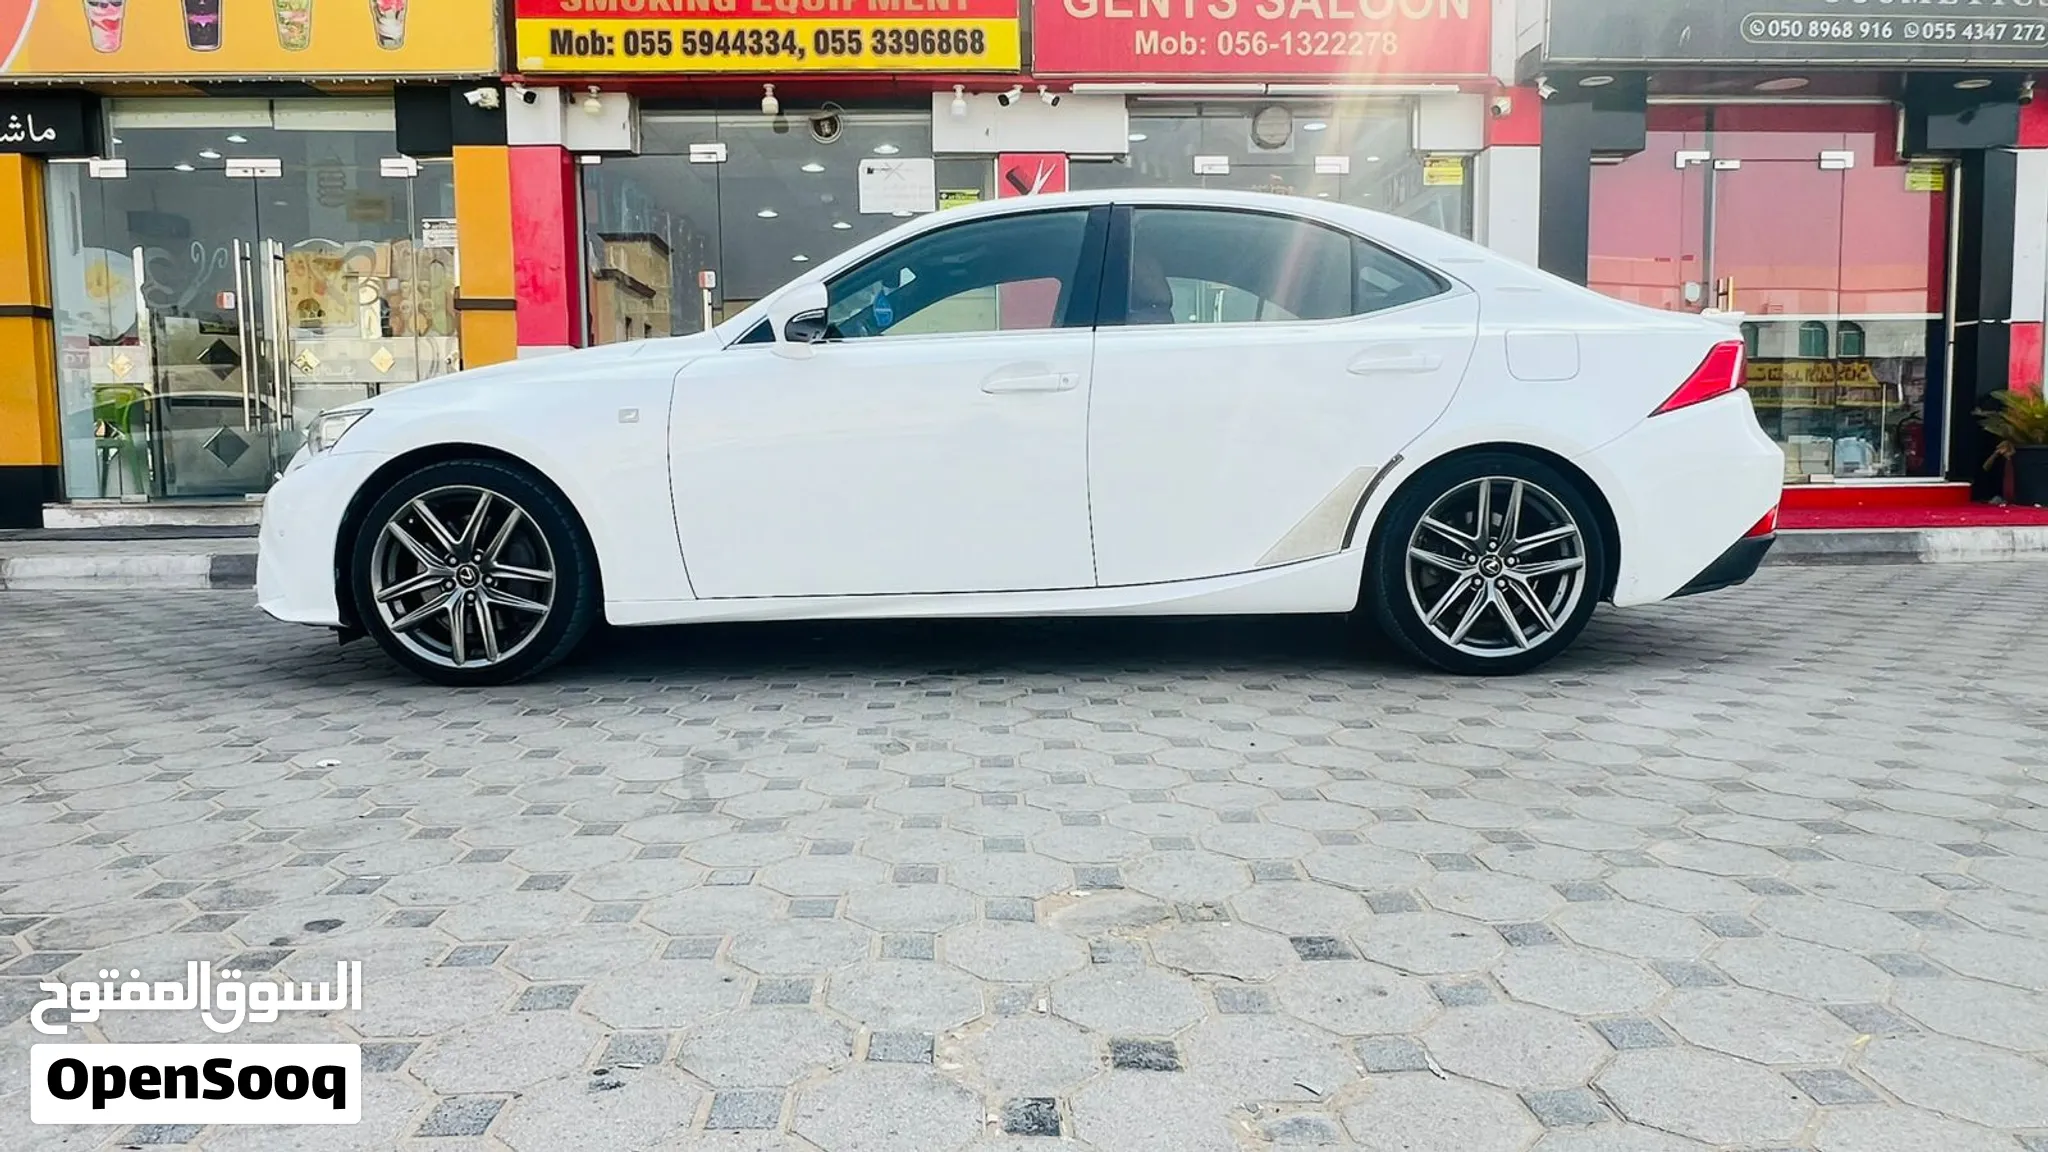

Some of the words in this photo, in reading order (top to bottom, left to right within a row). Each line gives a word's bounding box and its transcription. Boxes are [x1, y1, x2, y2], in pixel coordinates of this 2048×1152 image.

[1135, 30, 1207, 56] Mob:
[1217, 30, 1398, 57] 056-1322278
[1768, 19, 1803, 37] 050
[1808, 20, 1853, 39] 8968
[1859, 21, 1893, 39] 916
[1922, 22, 1956, 40] 055
[1961, 23, 2007, 41] 4347
[2012, 24, 2046, 41] 272
[549, 28, 614, 56] Mob:
[623, 29, 672, 56] 055
[682, 29, 806, 61] 5944334,
[814, 29, 862, 55] 055
[871, 29, 985, 55] 3396868
